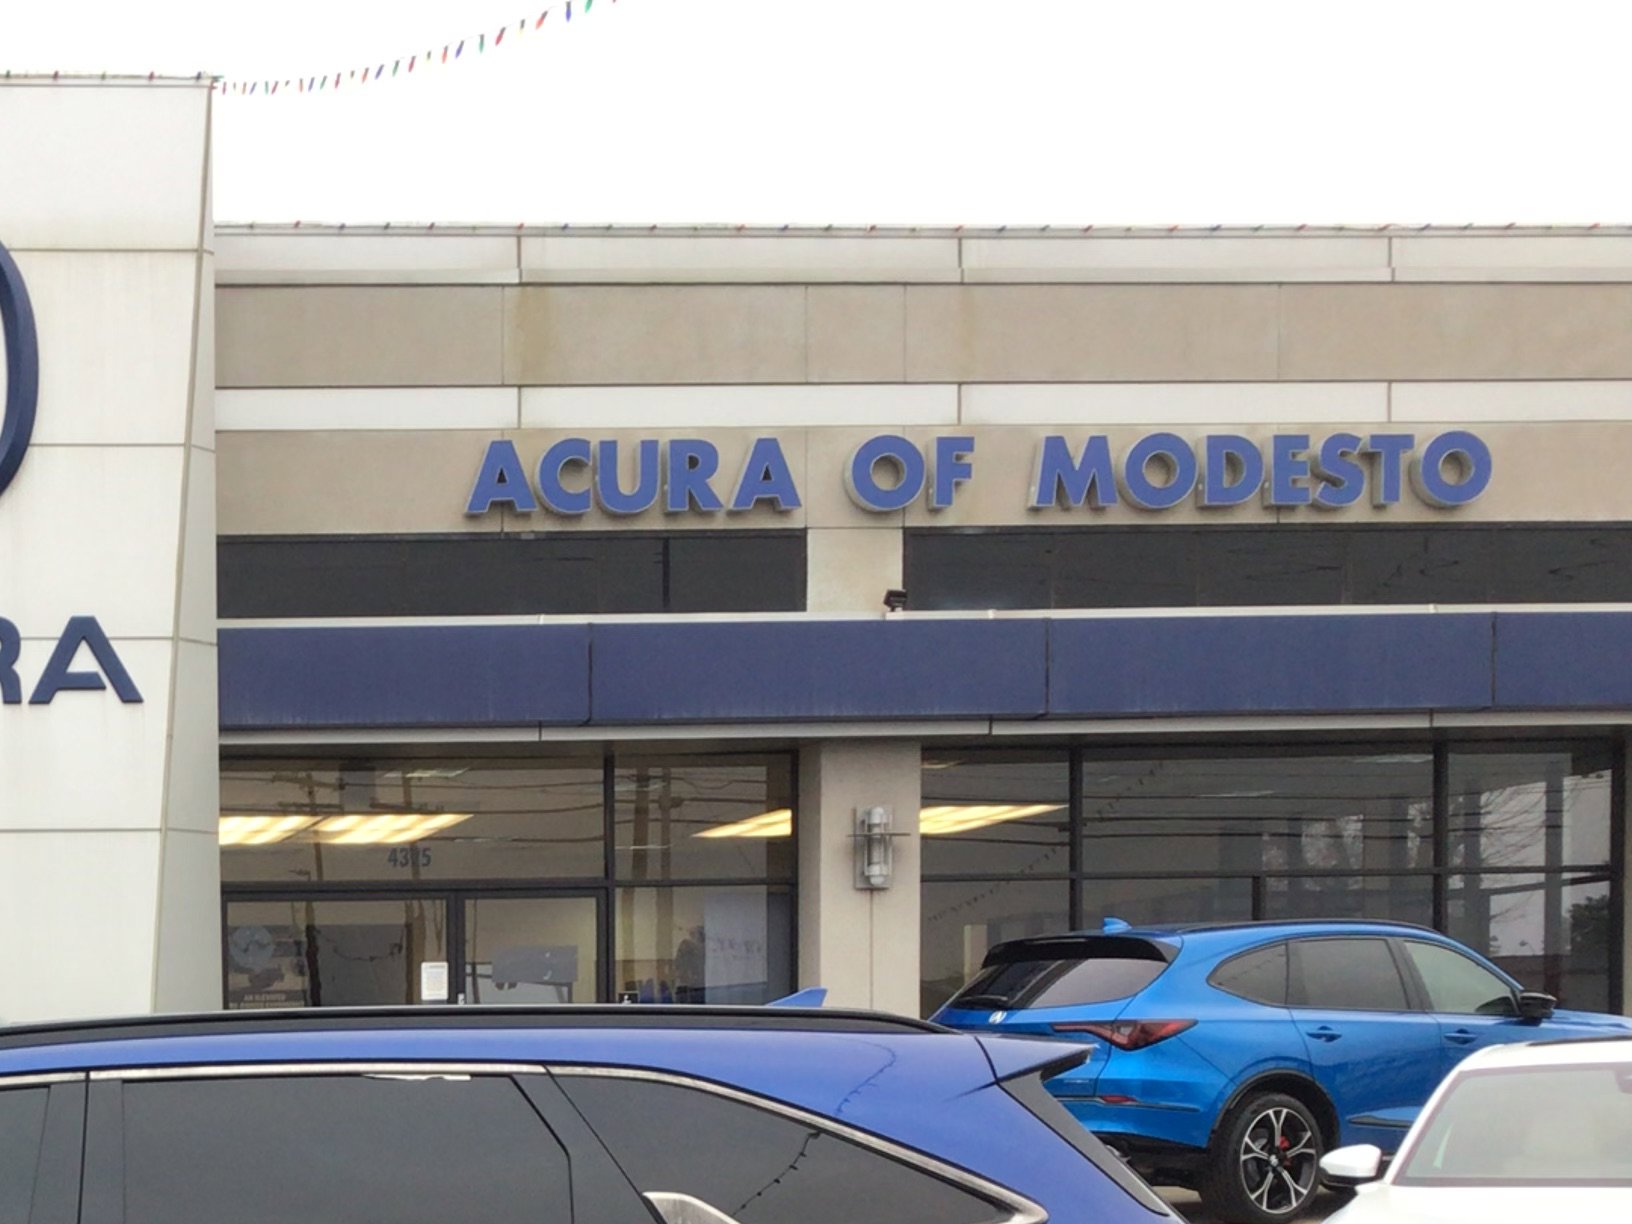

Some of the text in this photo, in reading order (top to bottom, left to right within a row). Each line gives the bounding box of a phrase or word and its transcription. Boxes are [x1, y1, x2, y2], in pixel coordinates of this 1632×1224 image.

[464, 430, 1493, 516] ACURA OF MODESTO
